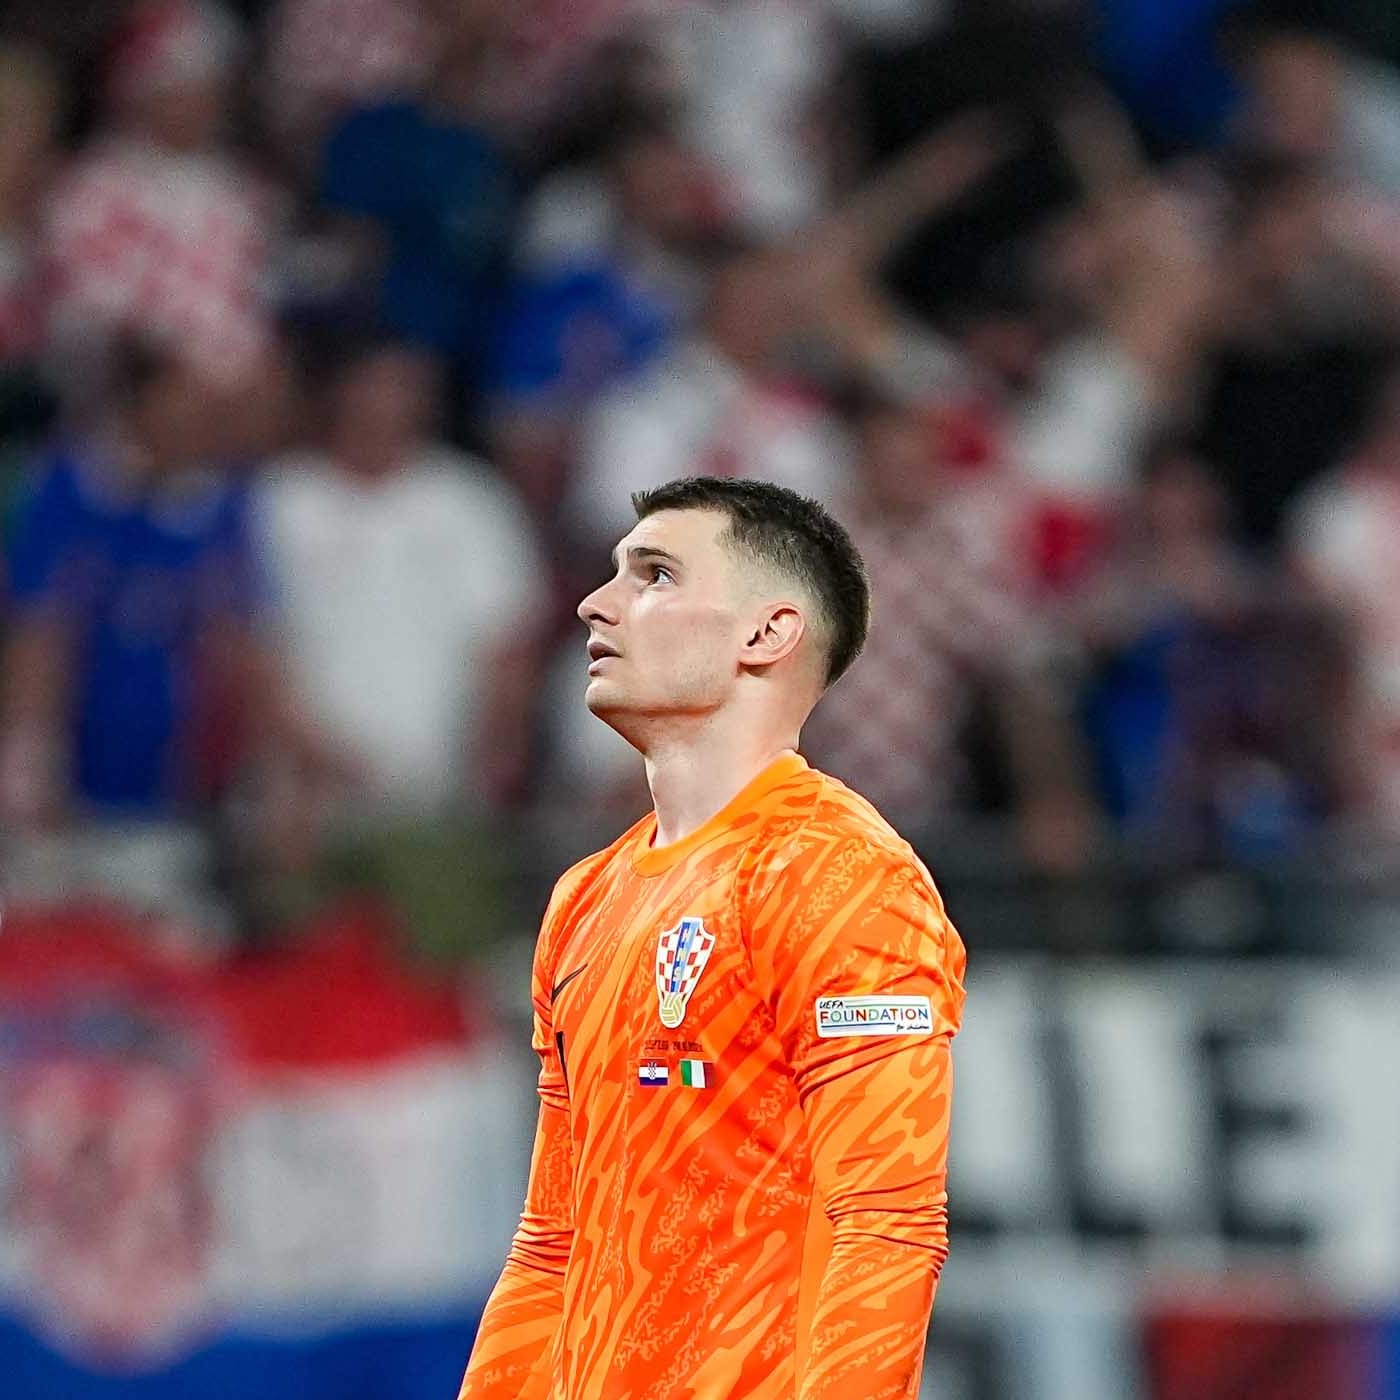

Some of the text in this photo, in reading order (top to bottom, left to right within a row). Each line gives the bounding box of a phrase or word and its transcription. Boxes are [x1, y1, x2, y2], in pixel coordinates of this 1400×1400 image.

[819, 1000, 844, 1009] UEFA
[820, 1008, 929, 1024] FOUNDATION
[948, 1015, 1315, 1248] LE
